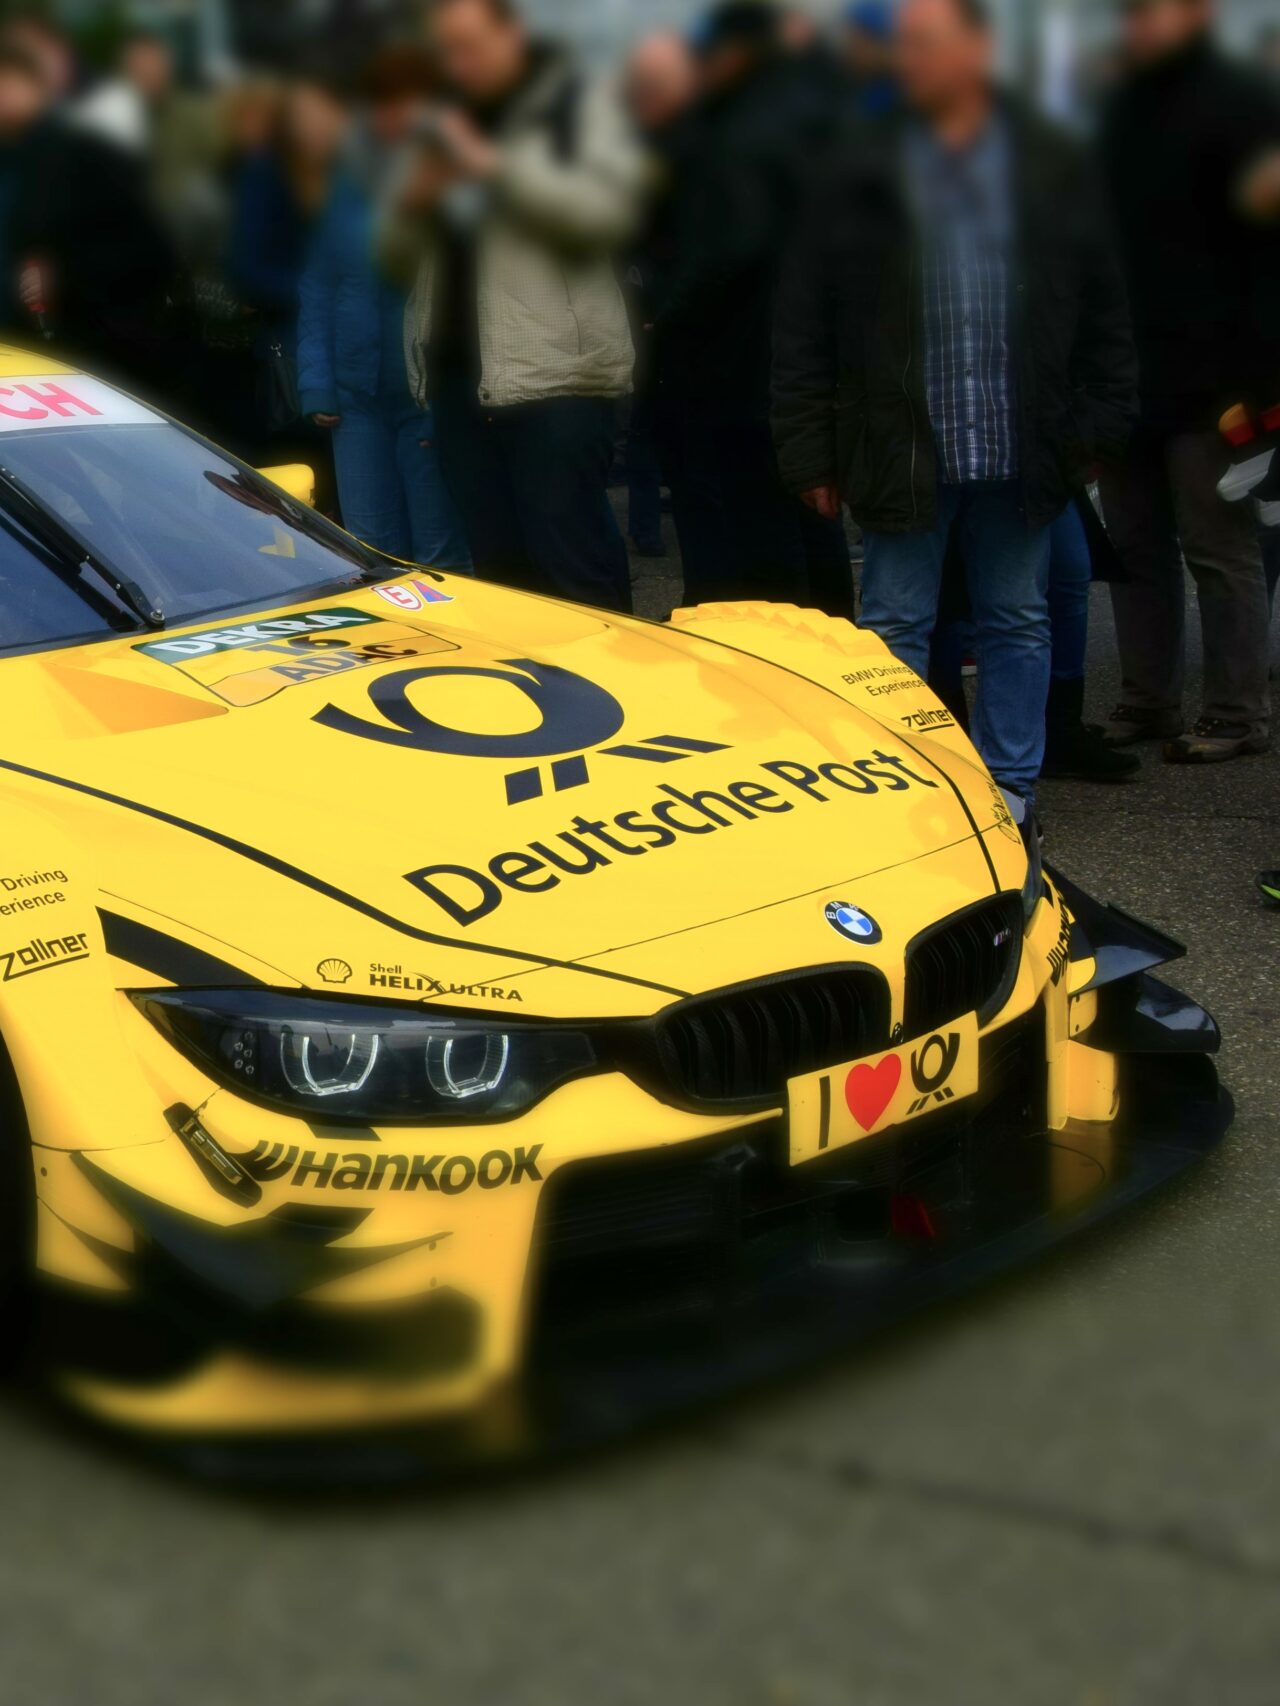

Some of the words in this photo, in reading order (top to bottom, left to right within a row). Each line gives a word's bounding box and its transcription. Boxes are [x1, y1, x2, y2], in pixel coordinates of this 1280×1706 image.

[149, 614, 371, 655] DEKRA
[248, 636, 351, 656] 16
[269, 644, 419, 682] ADAC
[841, 668, 876, 685] BMW
[873, 663, 911, 679] Driving
[865, 677, 926, 697] Experience
[401, 781, 795, 927] Deutsche
[759, 749, 939, 803] Post
[0, 870, 69, 892] Driving
[370, 963, 402, 974] Shell
[369, 973, 447, 994] HELIX
[449, 983, 524, 1002] ULTRA
